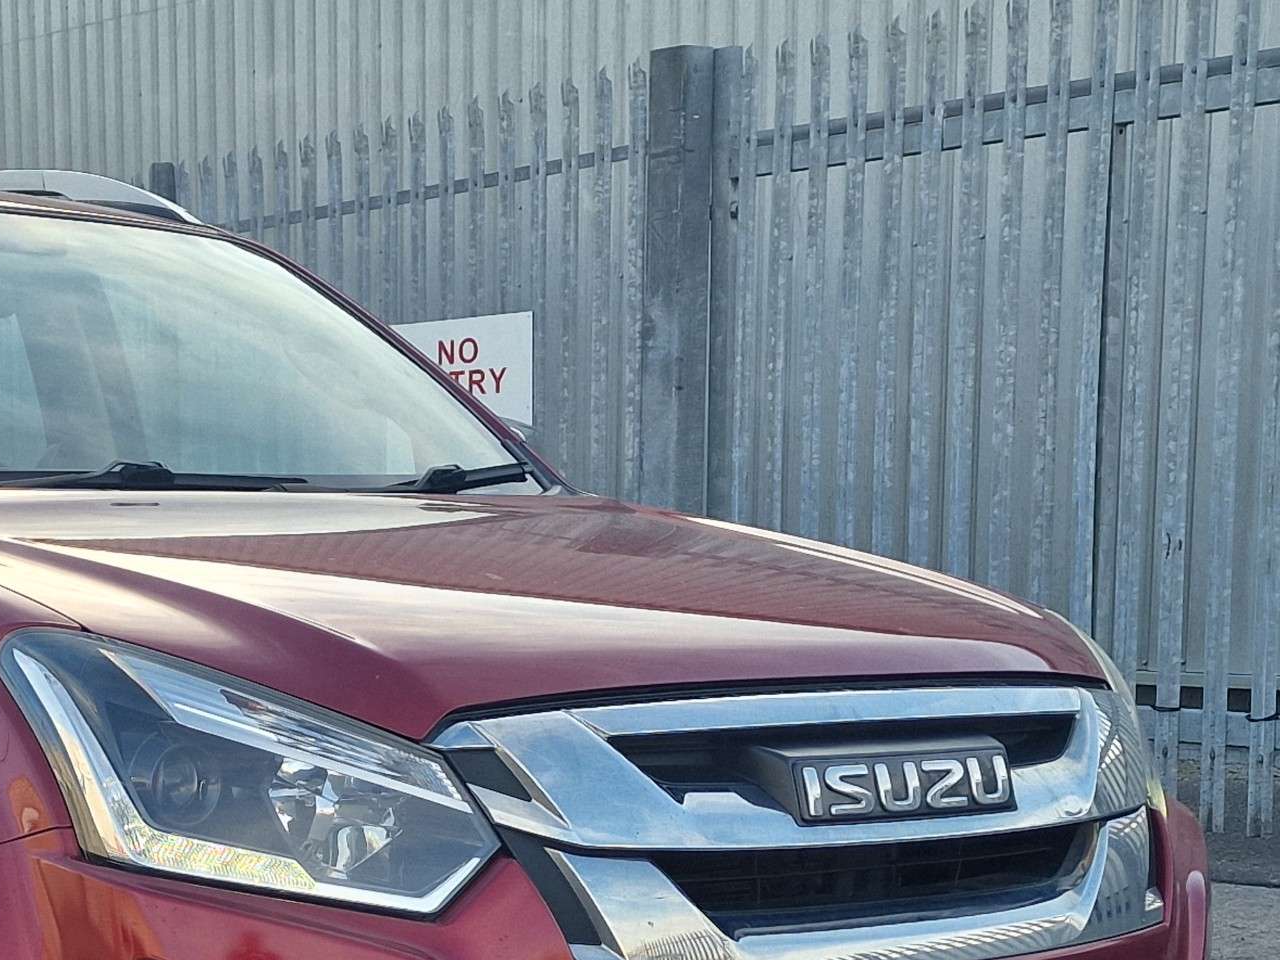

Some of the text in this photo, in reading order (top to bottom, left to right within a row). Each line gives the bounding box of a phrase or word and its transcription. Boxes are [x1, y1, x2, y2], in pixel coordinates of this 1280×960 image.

[437, 337, 479, 366] NO
[449, 367, 507, 395] TRY
[801, 755, 1011, 817] ISUZU
